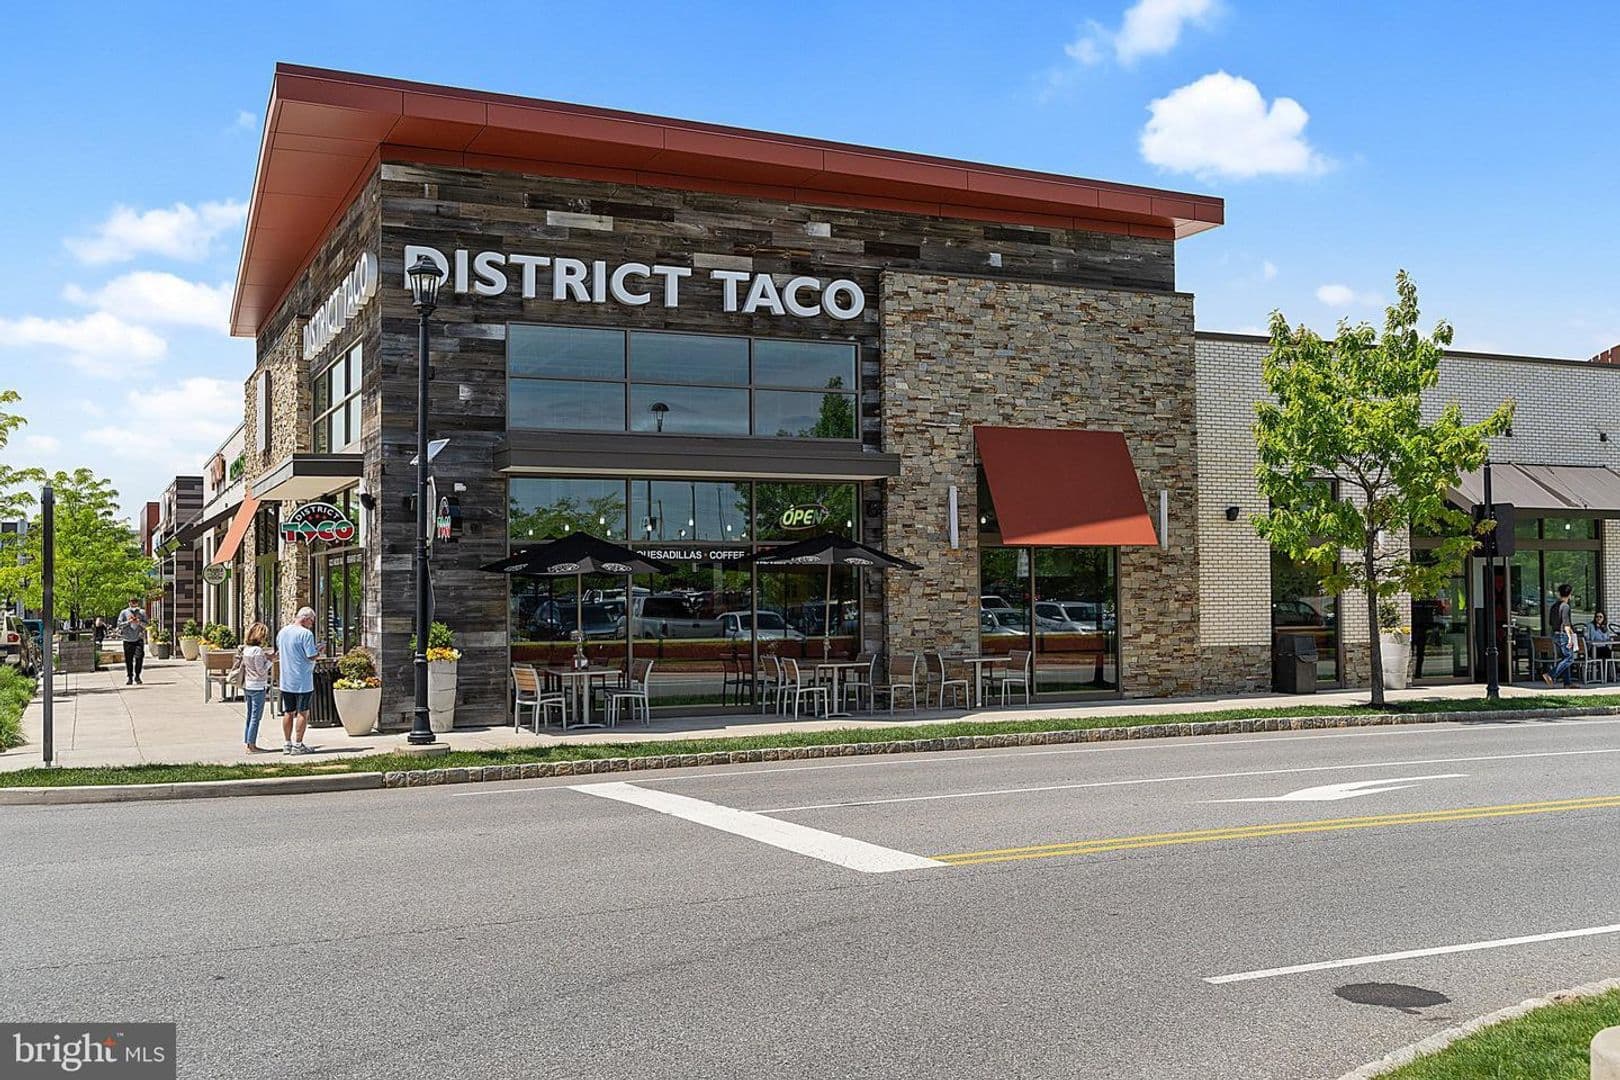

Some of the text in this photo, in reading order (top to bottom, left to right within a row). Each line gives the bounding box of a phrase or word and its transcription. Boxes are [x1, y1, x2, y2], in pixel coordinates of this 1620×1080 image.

[404, 244, 865, 320] DISTRICT TACO
[294, 505, 340, 521] DISTRICT
[281, 519, 355, 545] TACO
